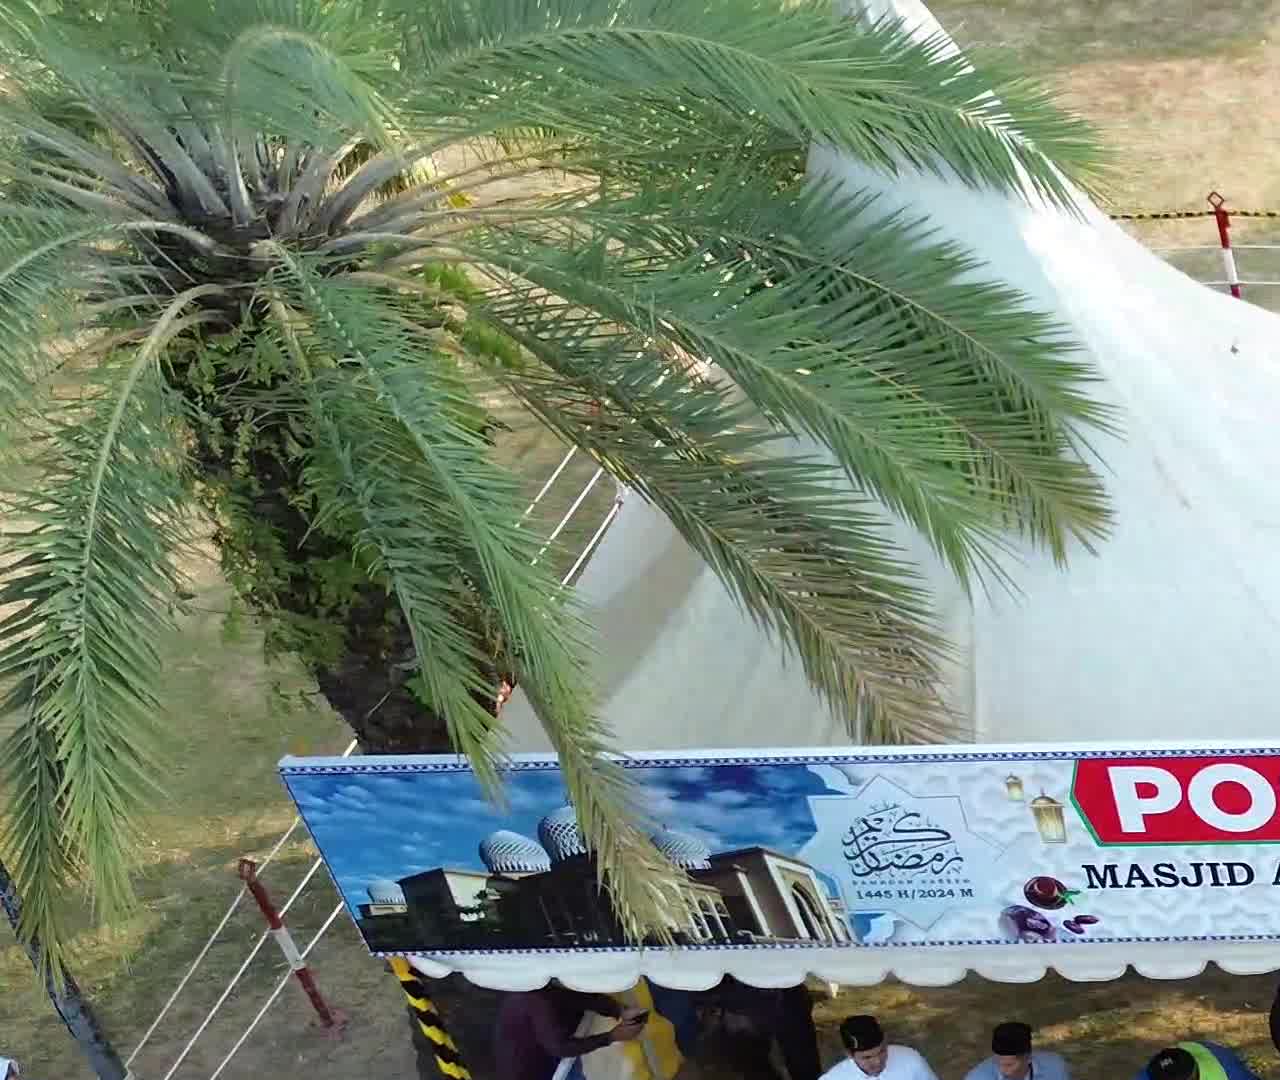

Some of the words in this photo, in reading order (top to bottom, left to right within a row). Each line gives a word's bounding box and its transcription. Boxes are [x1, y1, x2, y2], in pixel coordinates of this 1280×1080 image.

[1082, 861, 1255, 890] MASJID
[856, 889, 893, 900] 1445
[897, 888, 955, 900] H/2024
[960, 888, 974, 898] M
